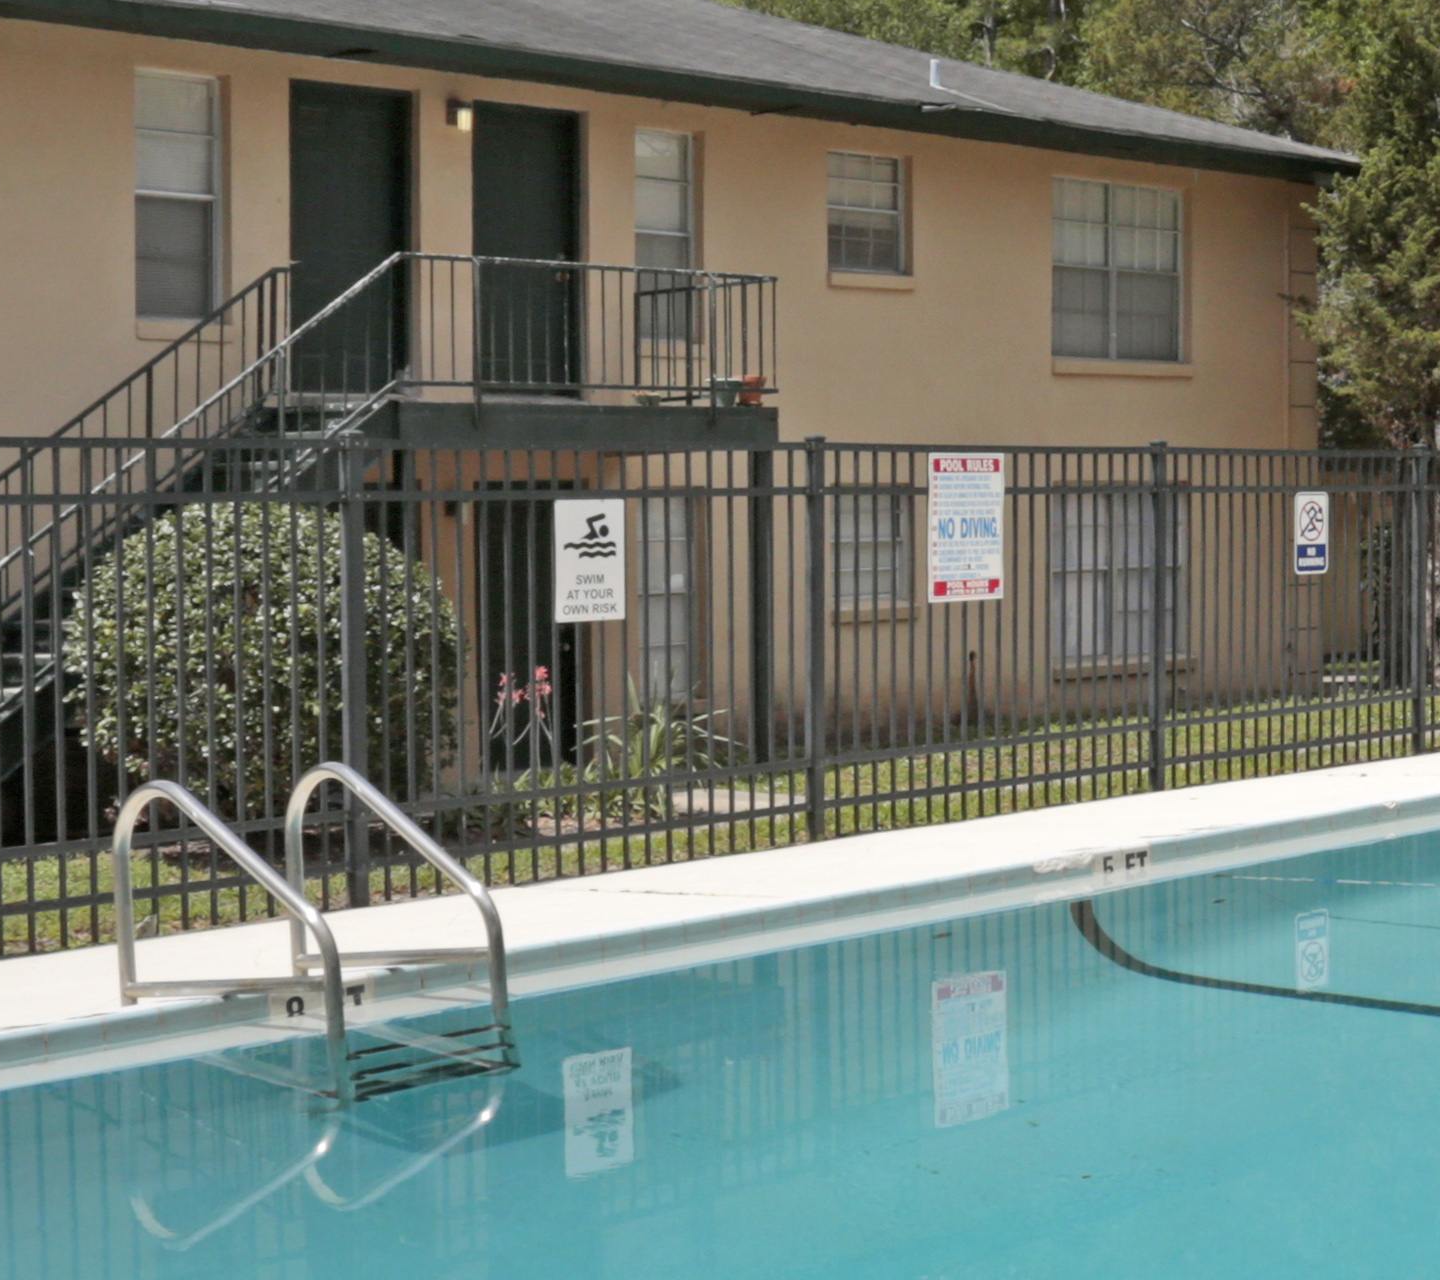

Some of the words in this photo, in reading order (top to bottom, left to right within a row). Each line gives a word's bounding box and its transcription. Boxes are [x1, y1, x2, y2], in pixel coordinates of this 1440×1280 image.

[940, 458, 964, 472] POOL
[967, 458, 994, 472] RULES
[938, 517, 955, 539] NO
[576, 574, 604, 585] SWIM
[566, 589, 580, 600] AT
[583, 587, 614, 599] YOUR
[562, 604, 589, 615] OWN
[592, 602, 618, 614] RISK
[1125, 850, 1148, 870] FT
